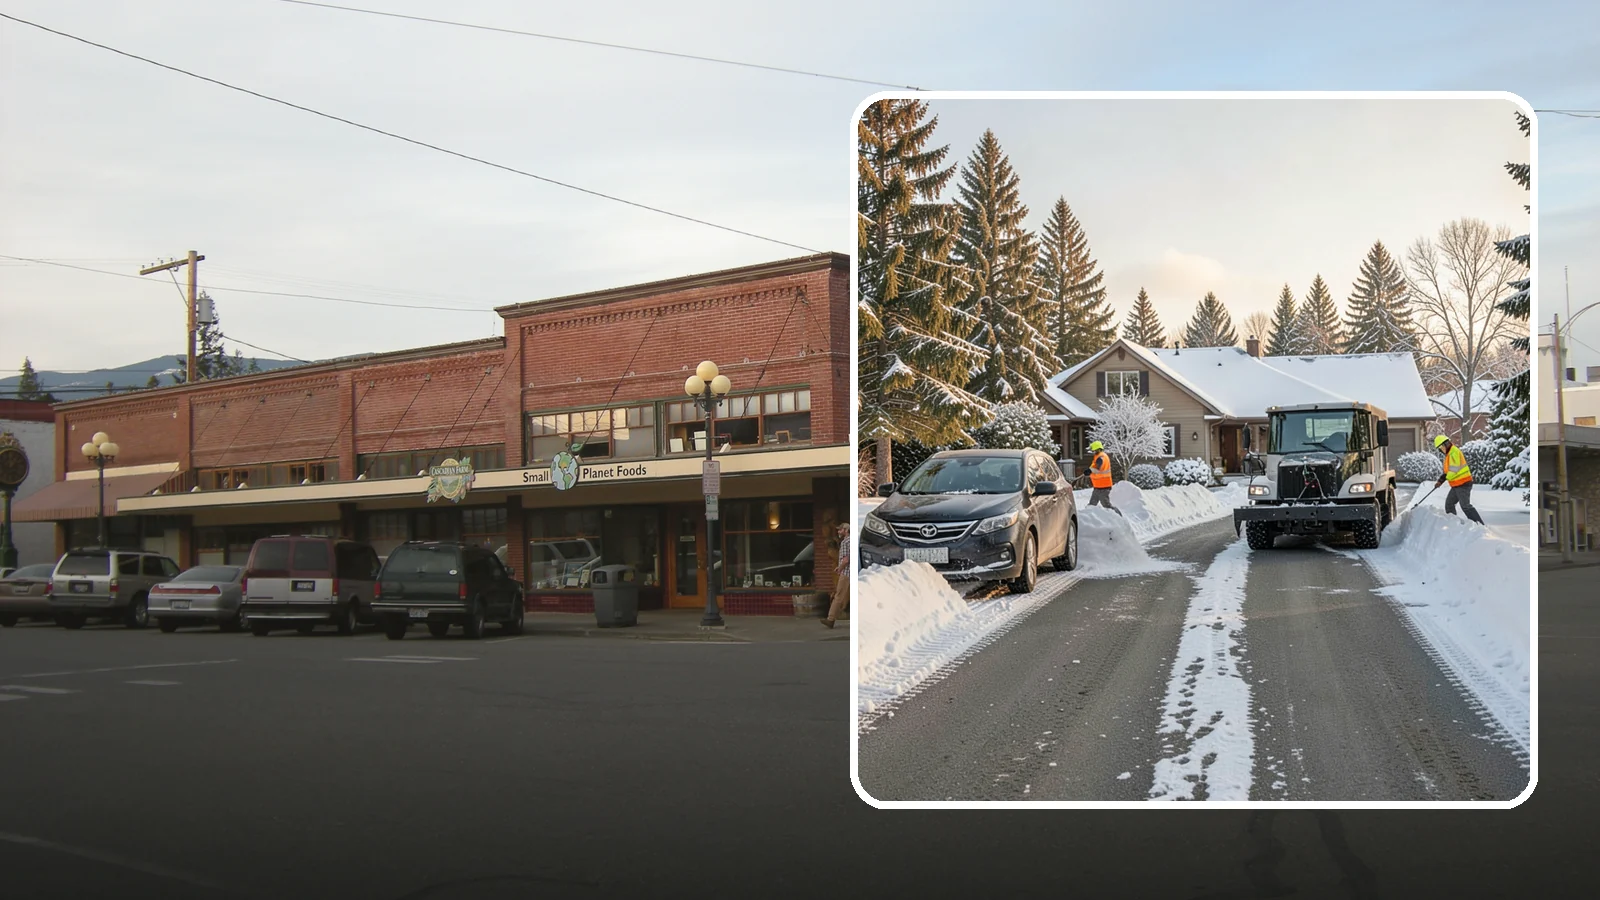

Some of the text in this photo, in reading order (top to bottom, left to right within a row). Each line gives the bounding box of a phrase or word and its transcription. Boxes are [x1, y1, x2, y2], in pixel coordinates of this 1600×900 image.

[523, 464, 647, 483] Small Planet Foods
